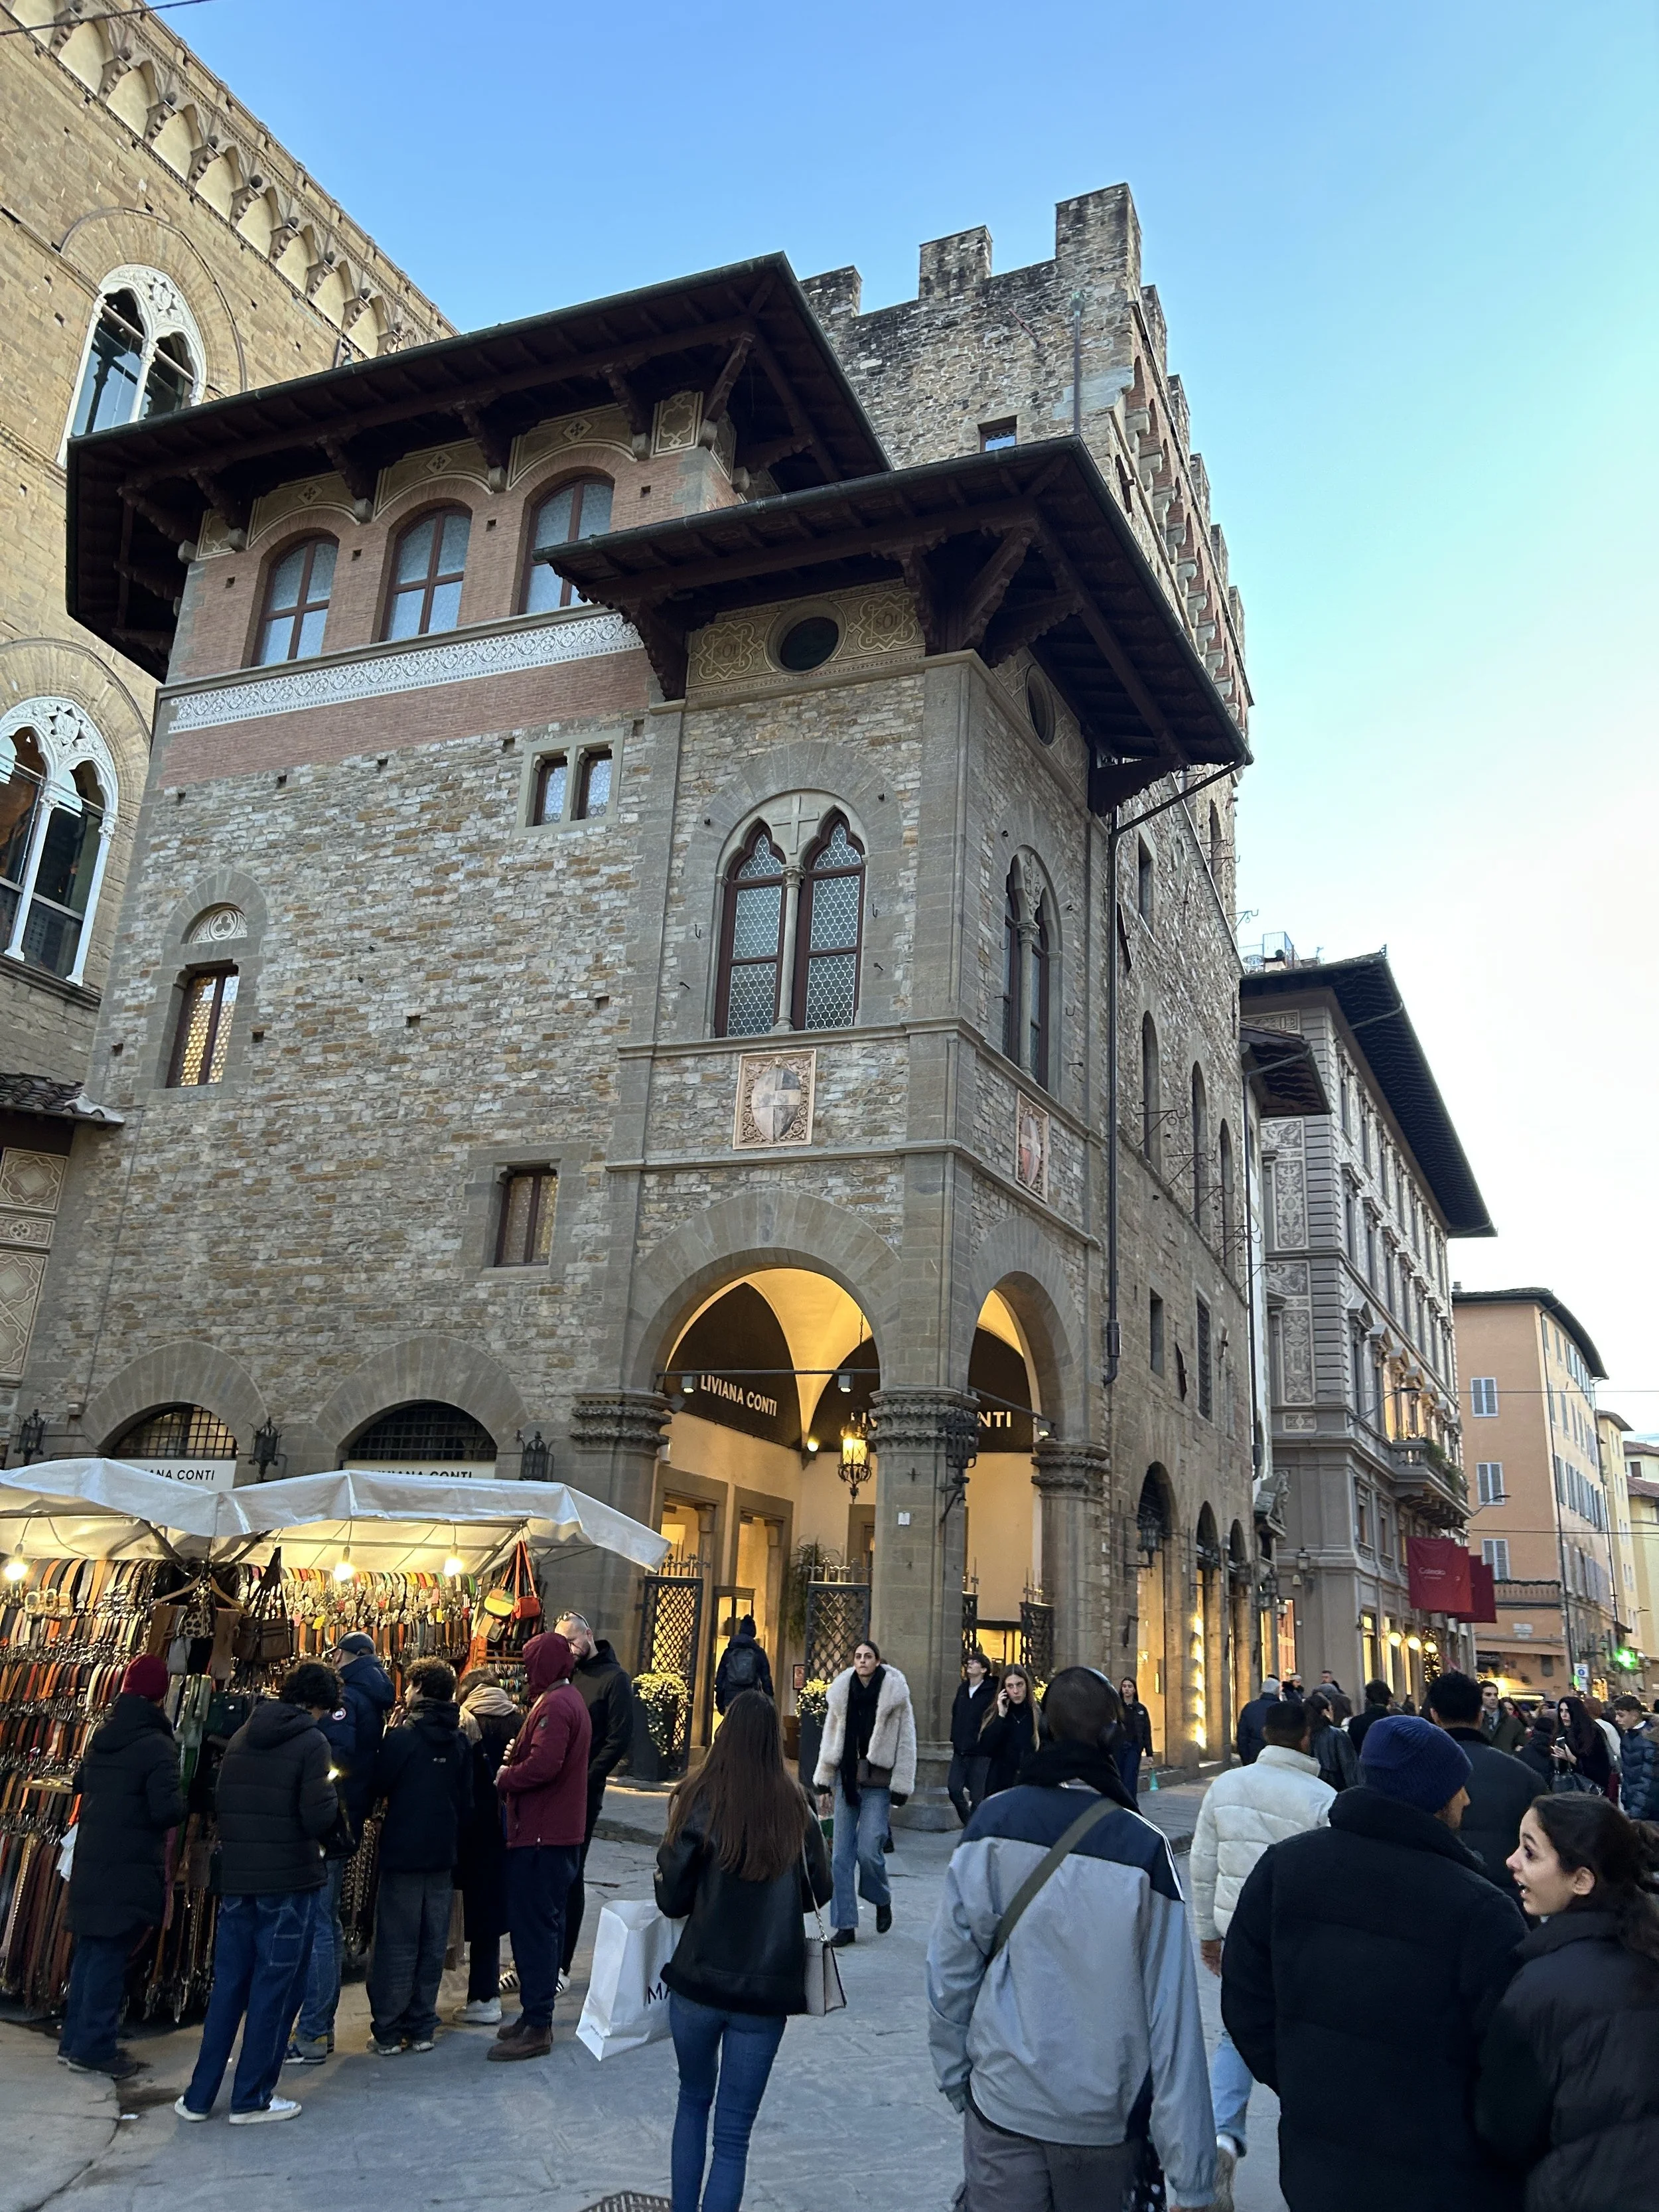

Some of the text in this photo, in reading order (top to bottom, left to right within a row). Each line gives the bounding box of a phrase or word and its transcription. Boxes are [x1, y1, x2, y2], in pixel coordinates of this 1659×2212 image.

[701, 1374, 777, 1416] LIVIANA CONTI
[977, 1411, 1011, 1428] NTI
[177, 1469, 215, 1481] CONTI
